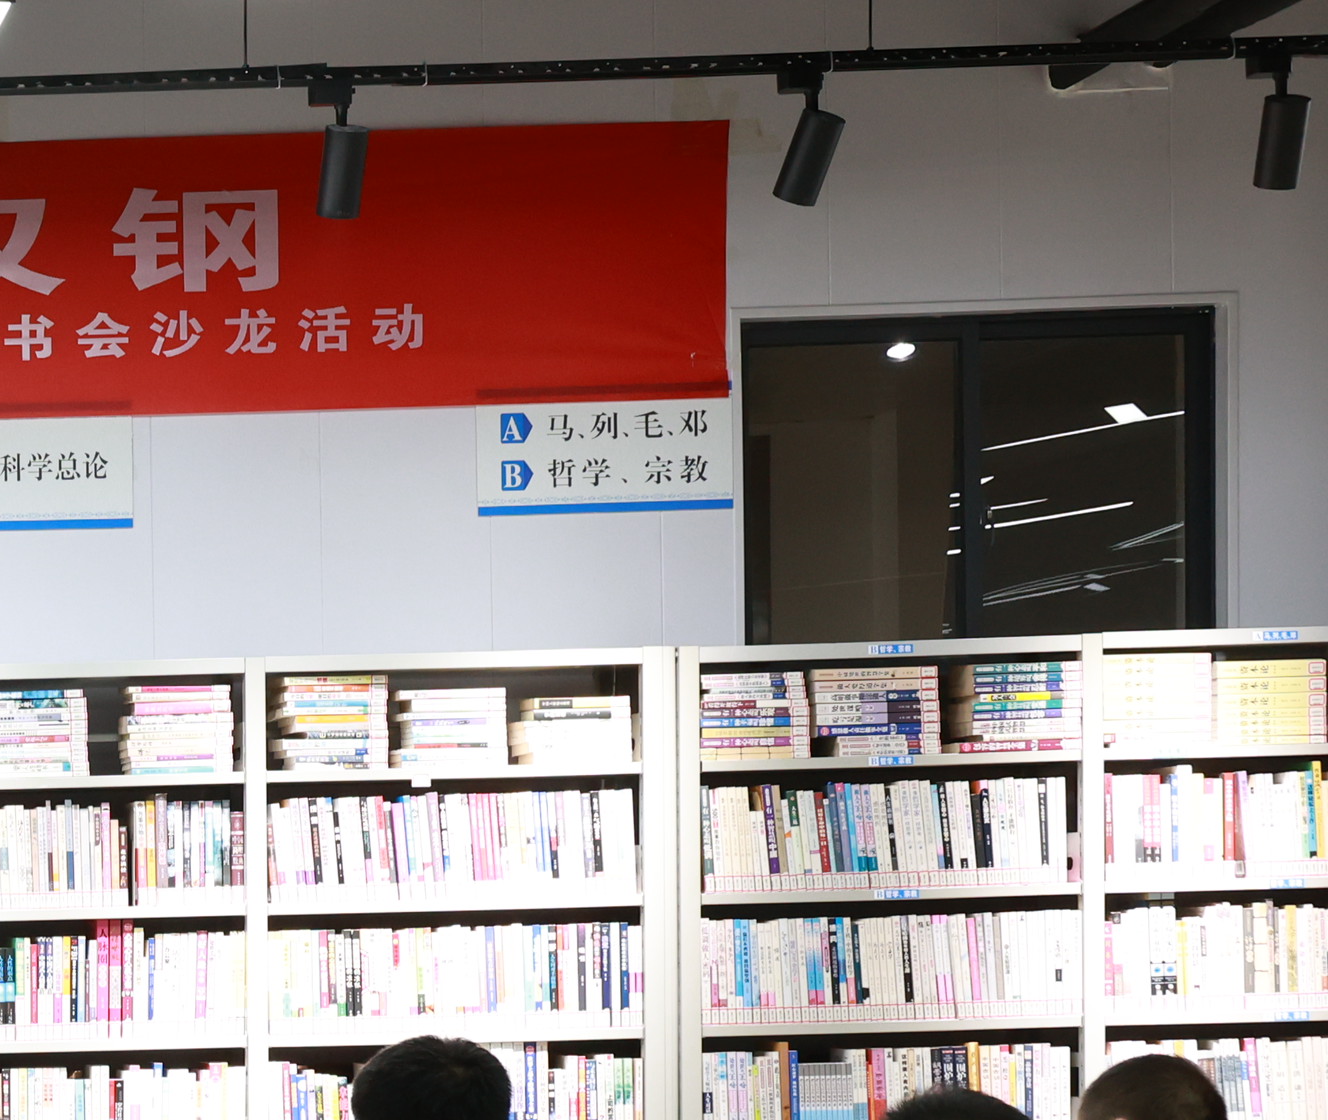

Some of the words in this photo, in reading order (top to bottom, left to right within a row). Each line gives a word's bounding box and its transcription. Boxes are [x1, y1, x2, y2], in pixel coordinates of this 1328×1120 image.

[502, 415, 521, 441] A
[547, 409, 708, 441] 马、列、毛、邓
[503, 463, 523, 488] B
[547, 455, 709, 488] 哲学、宗教
